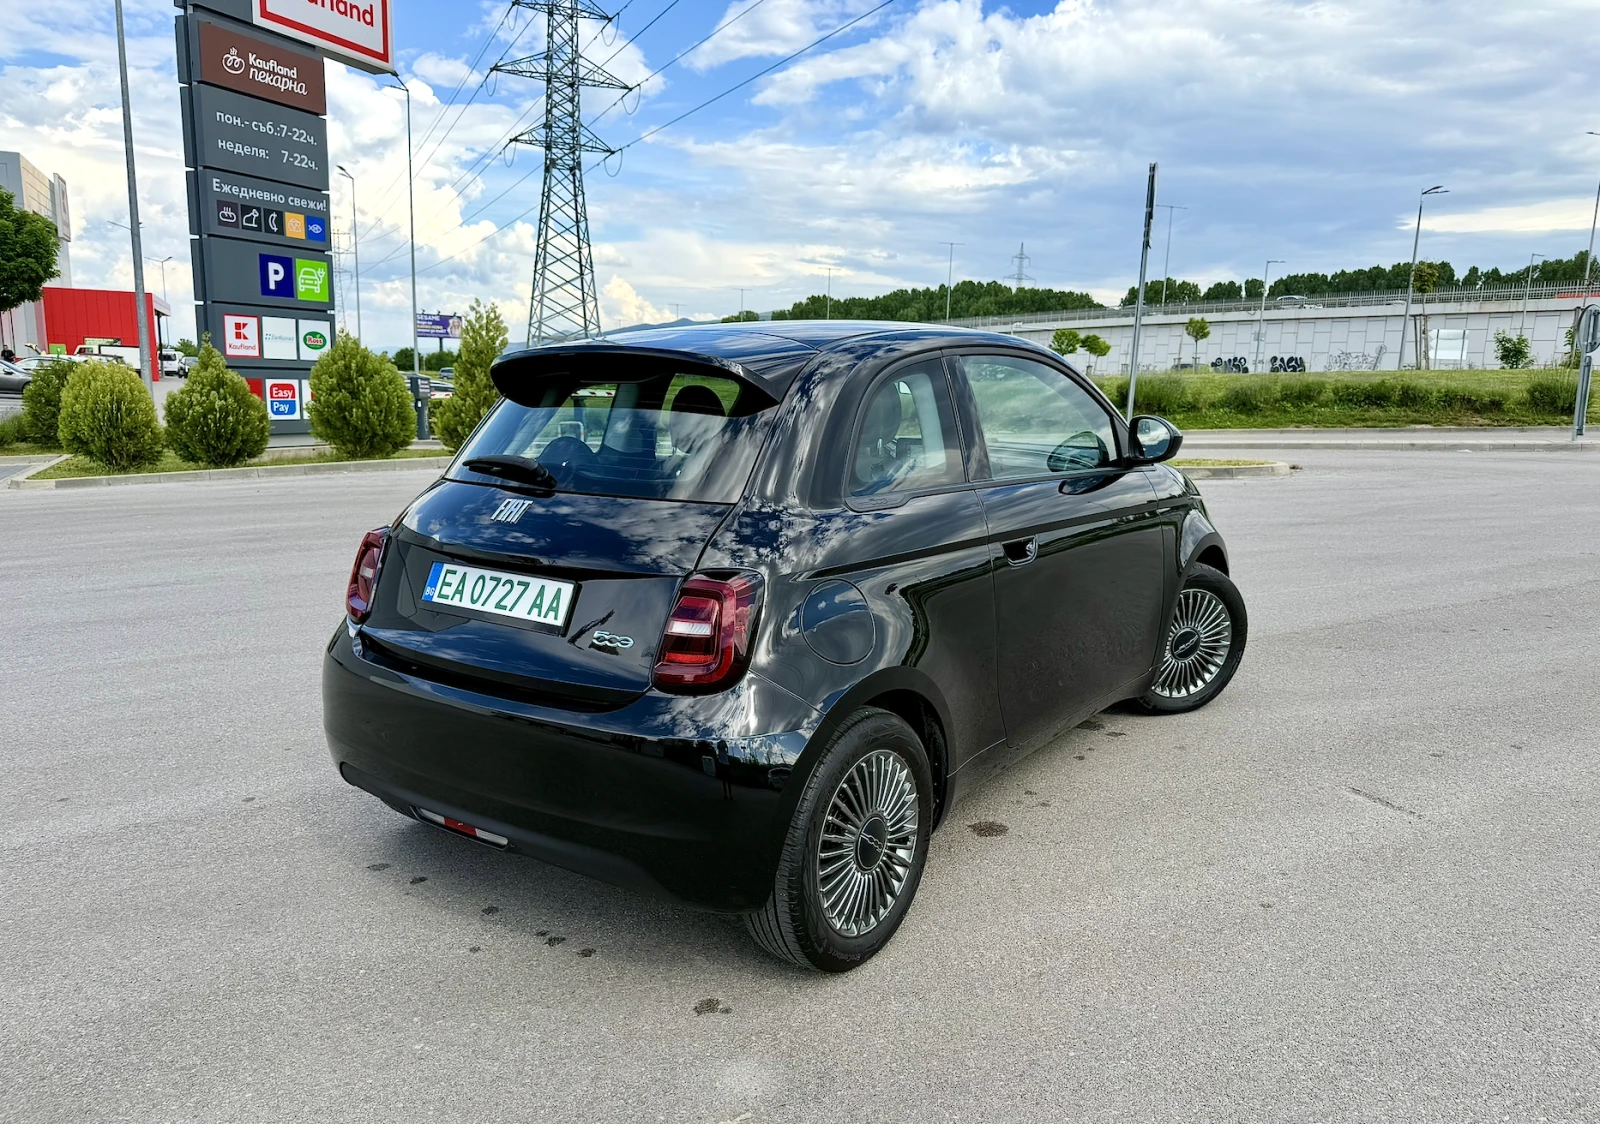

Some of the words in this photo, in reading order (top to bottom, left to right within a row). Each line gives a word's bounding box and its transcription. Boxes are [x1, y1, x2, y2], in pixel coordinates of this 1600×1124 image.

[248, 52, 297, 79] Kaufland
[249, 67, 308, 96] пекарна
[218, 139, 269, 160] неделя:
[281, 150, 319, 171] 7-22ч.
[212, 178, 285, 204] Ежедневно
[288, 195, 327, 211] свежи!
[268, 262, 285, 290] P
[228, 343, 256, 351] Kaufland
[272, 387, 293, 399] Easy
[273, 401, 290, 413] Pay
[490, 498, 533, 524] FIAT
[425, 586, 435, 596] BG
[437, 568, 468, 602] EA
[471, 574, 531, 612] 0727
[527, 585, 563, 621] AA
